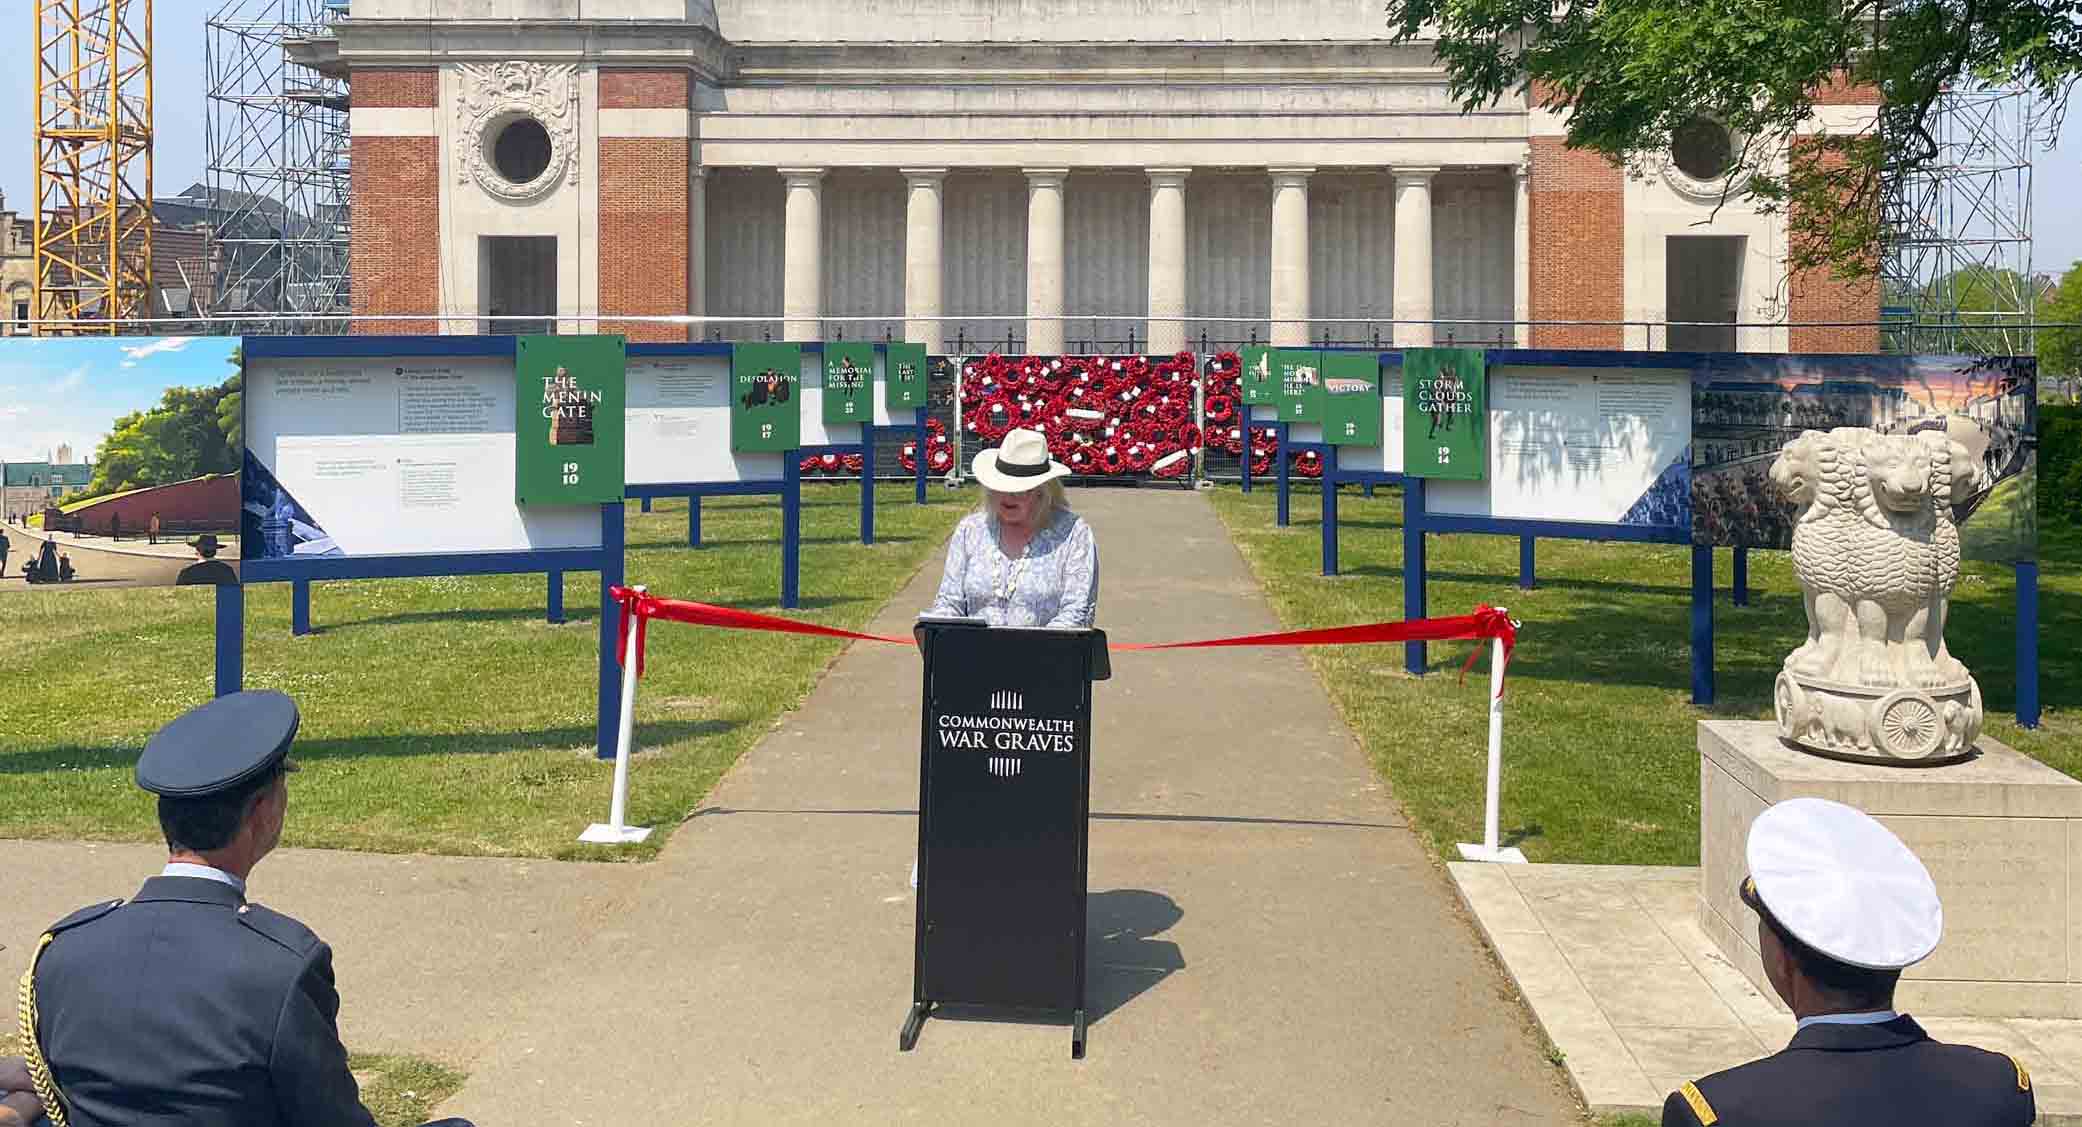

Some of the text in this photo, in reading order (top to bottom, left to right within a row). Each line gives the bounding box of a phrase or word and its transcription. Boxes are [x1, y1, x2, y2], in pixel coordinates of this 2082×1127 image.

[828, 367, 872, 375] MEMORIAL
[541, 376, 577, 389] THE
[1418, 379, 1464, 389] STORM
[1328, 384, 1370, 392] VICTORY
[542, 391, 602, 403] MENIN
[1418, 391, 1472, 401] CLOUDS
[542, 405, 587, 418] GATE
[1418, 402, 1472, 412] GATHER
[762, 431, 772, 439] 17
[1438, 446, 1450, 455] 19
[1438, 455, 1449, 464] 14
[563, 462, 579, 473] 19
[563, 473, 579, 485] 10
[938, 714, 1075, 733] COMMONWEALTH
[939, 729, 1074, 752] WAR GRAVES
